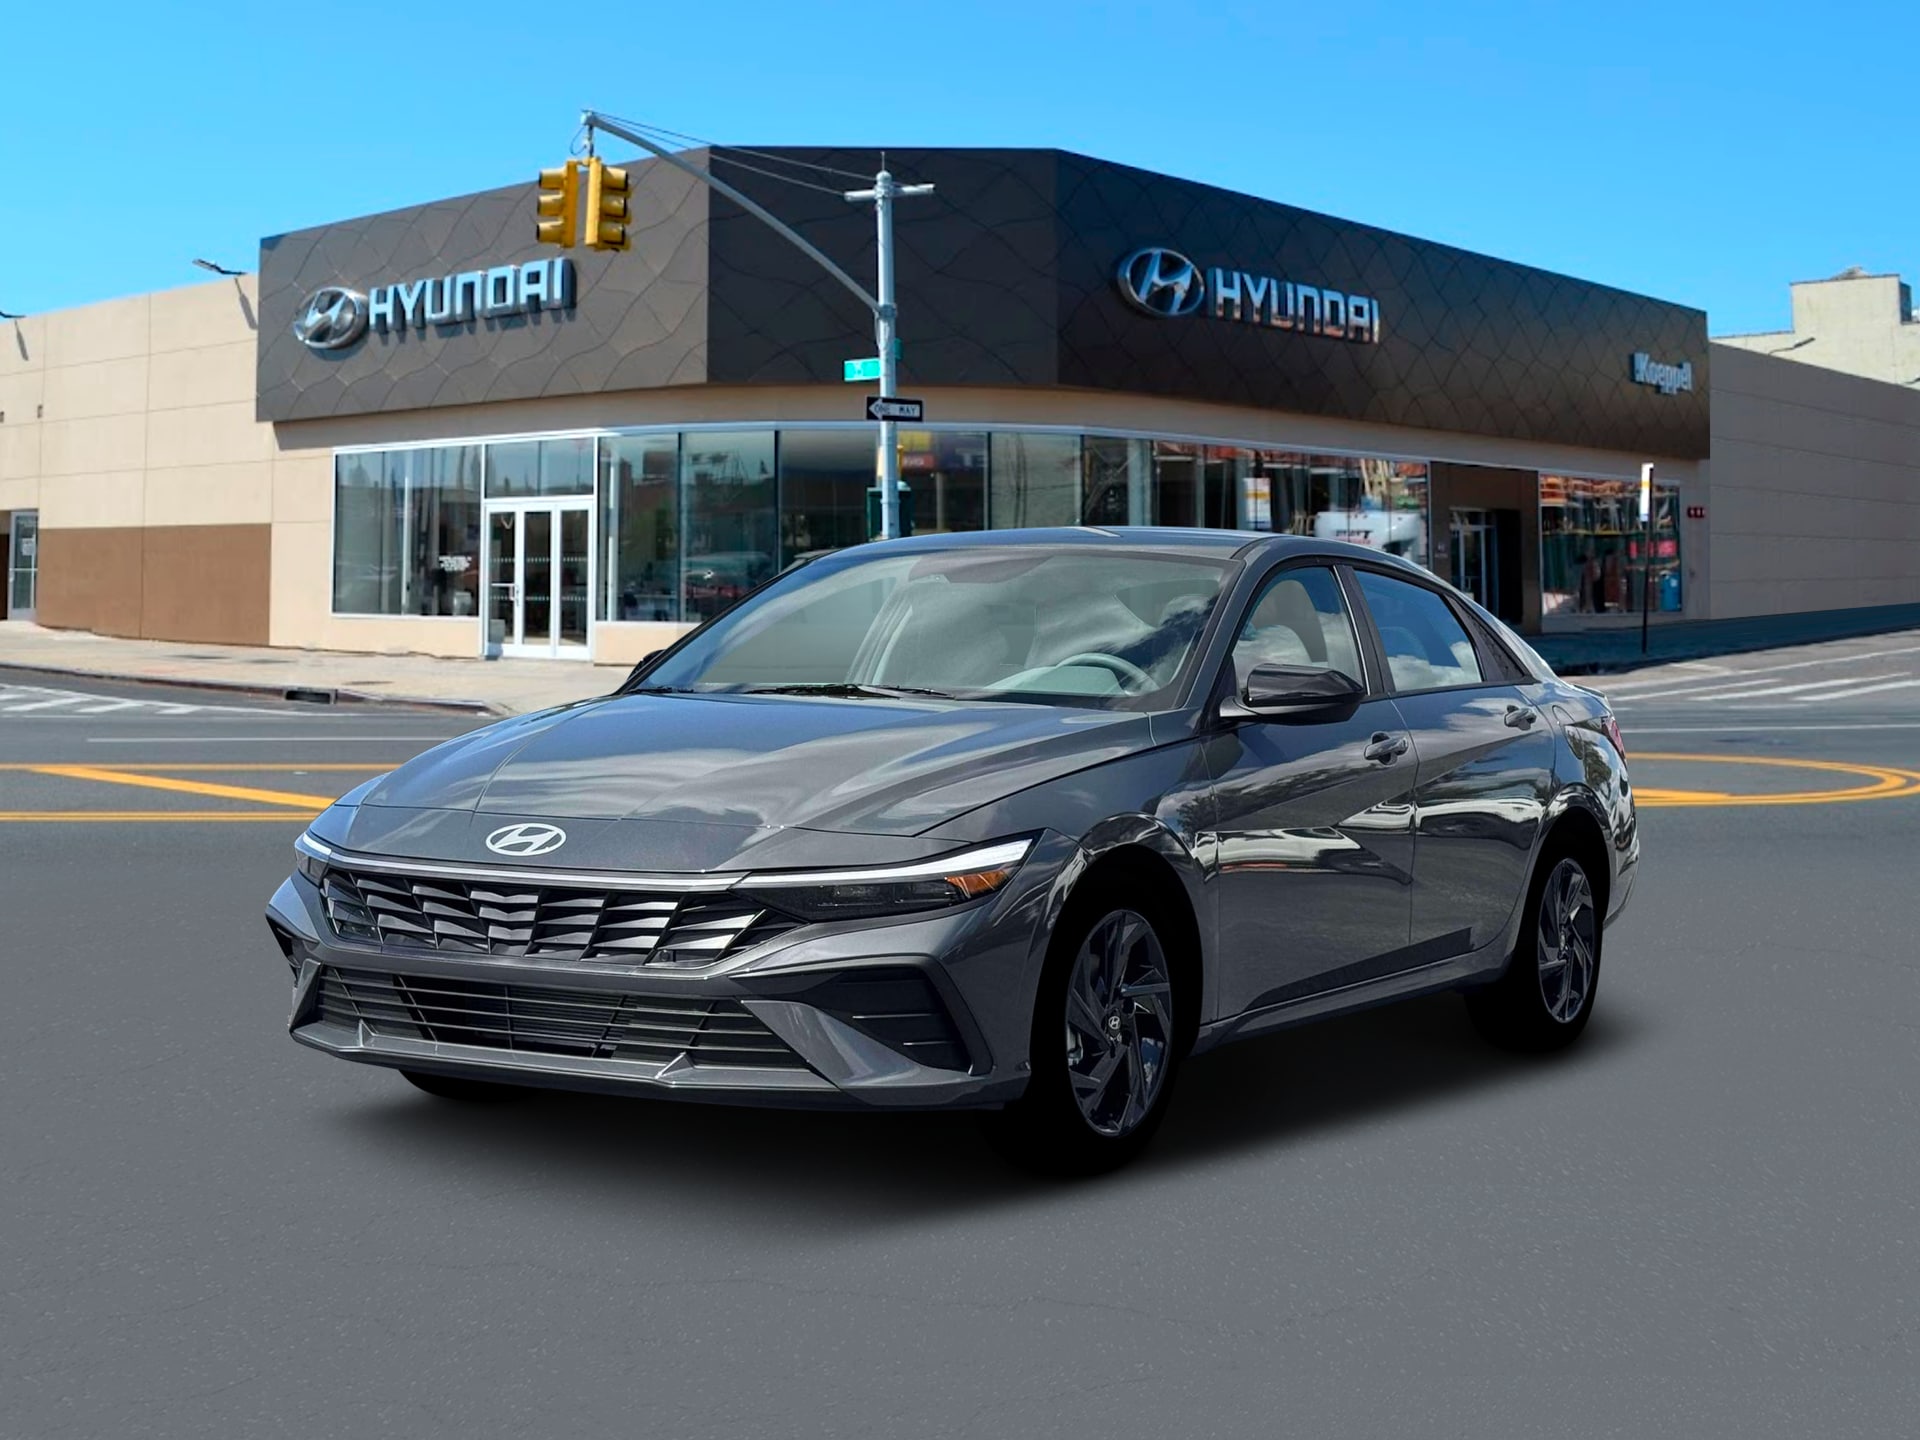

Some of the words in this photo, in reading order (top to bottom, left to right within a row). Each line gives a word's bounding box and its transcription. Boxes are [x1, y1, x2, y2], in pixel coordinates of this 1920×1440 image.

[368, 256, 572, 330] HYUNDAI
[1212, 267, 1380, 344] HYUNDAI
[1634, 352, 1692, 394] Koeppel
[874, 403, 891, 415] ONE
[898, 405, 917, 416] WAY
